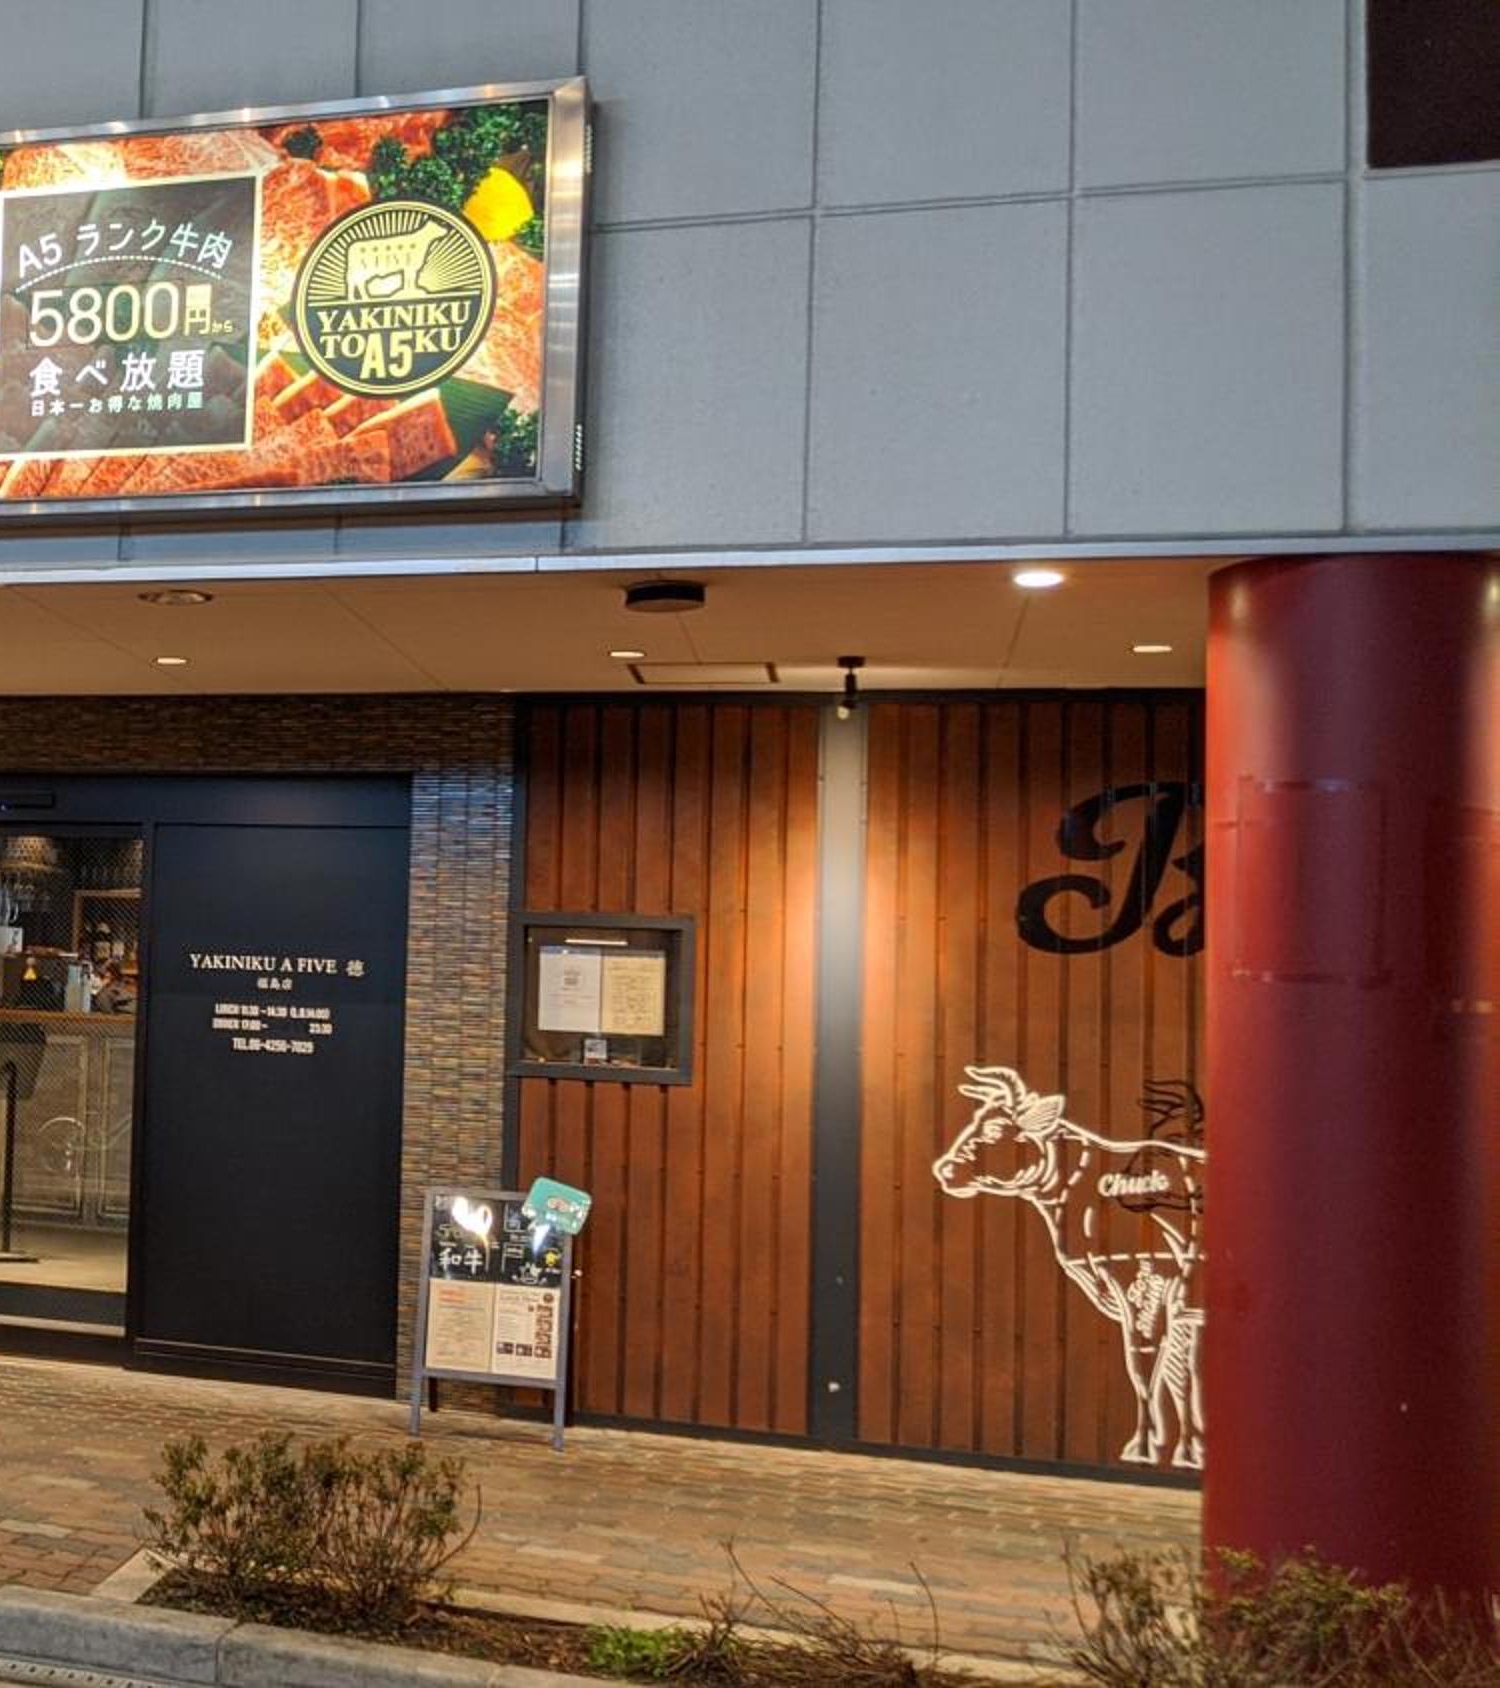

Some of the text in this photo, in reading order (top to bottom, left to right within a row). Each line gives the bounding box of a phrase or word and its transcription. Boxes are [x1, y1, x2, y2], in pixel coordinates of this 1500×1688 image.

[316, 301, 472, 334] YAKINIKU
[29, 349, 206, 397] 食べ放題
[189, 953, 276, 972] YAKINIKU
[279, 957, 293, 972] A
[296, 957, 338, 974] FIVE
[1098, 1169, 1170, 1197] Chuck
[438, 1247, 484, 1275] 和牛
